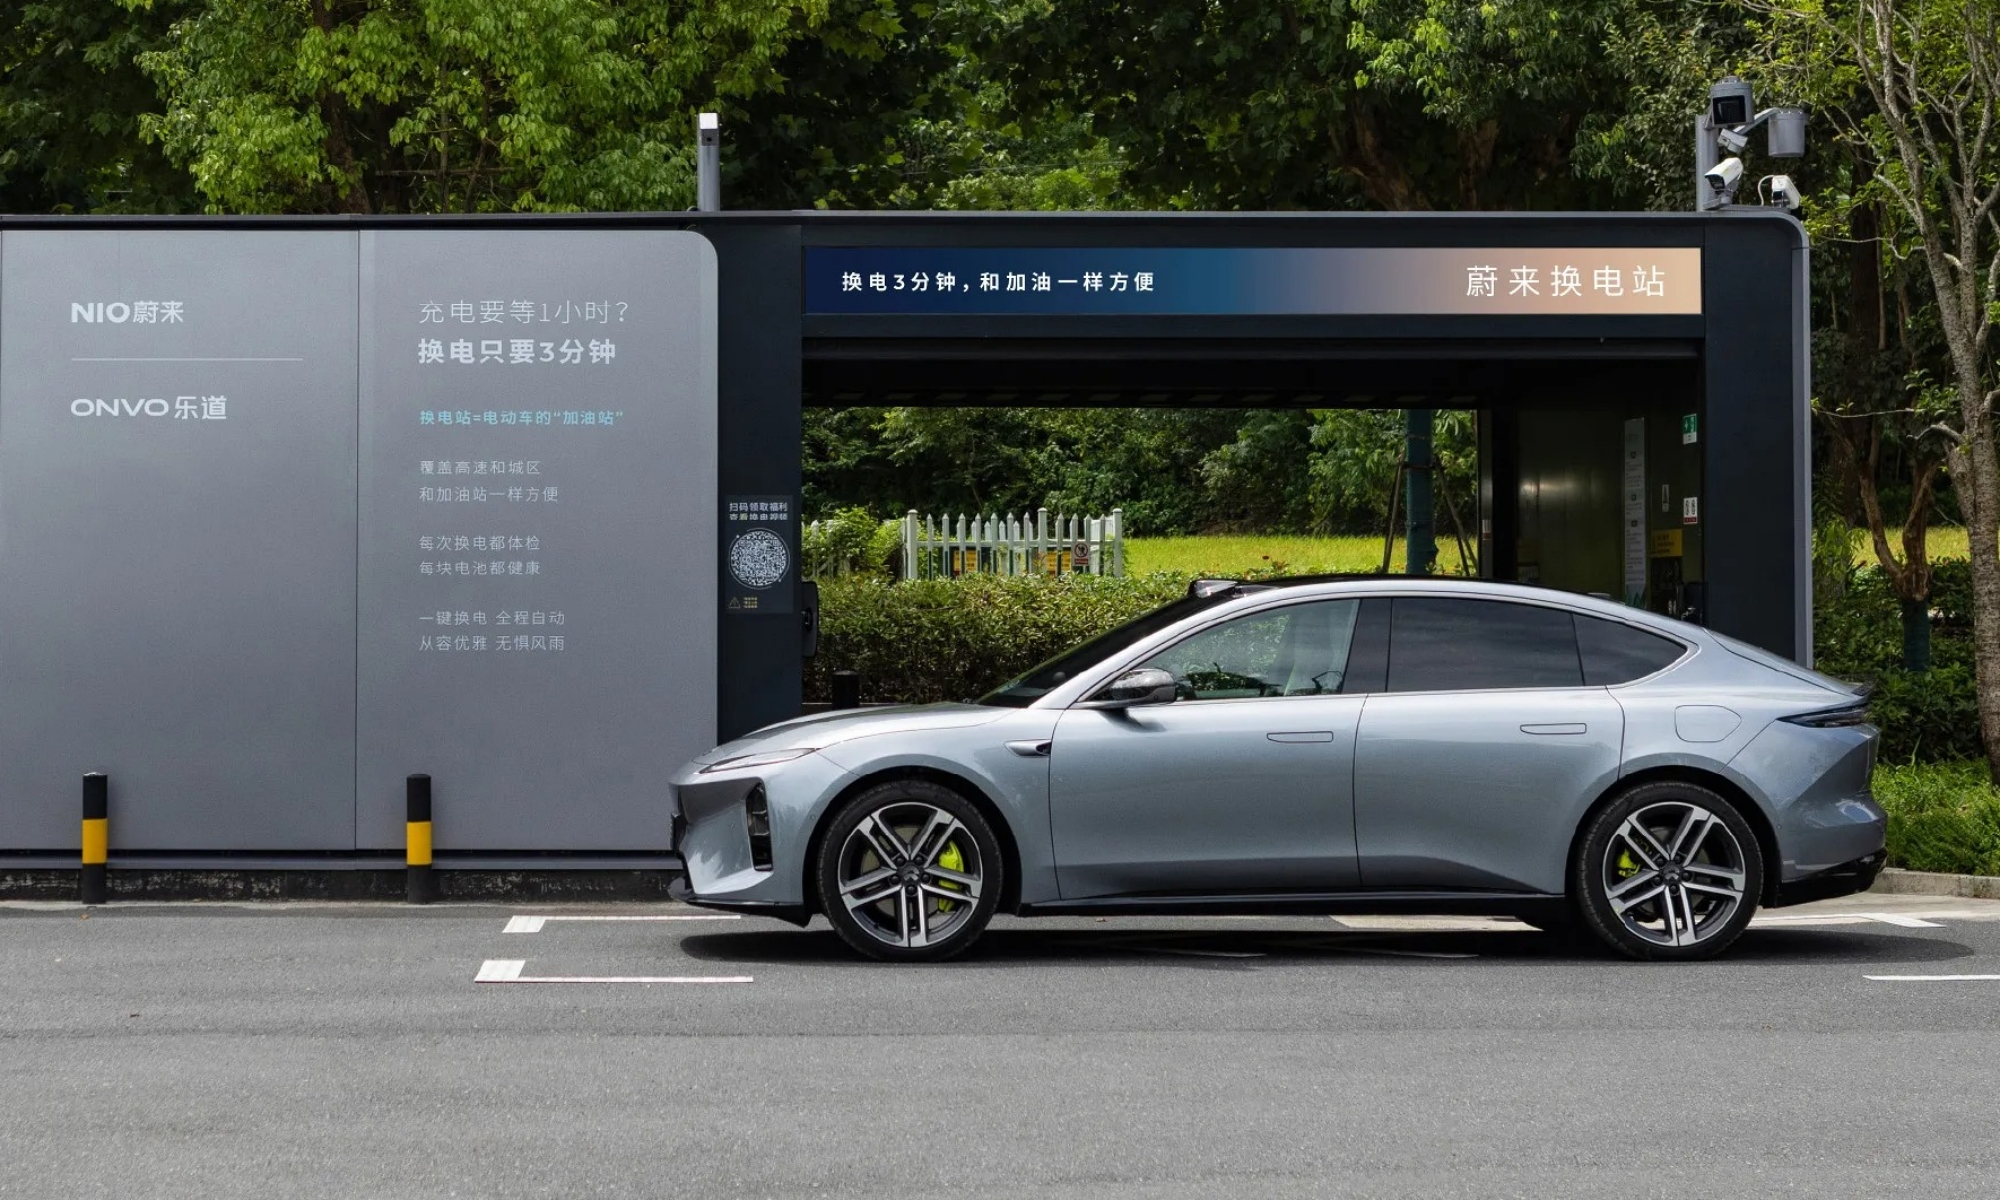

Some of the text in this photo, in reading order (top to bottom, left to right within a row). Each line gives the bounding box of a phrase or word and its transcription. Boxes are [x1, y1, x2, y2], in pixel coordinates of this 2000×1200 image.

[842, 271, 1154, 292] 换电3分钟，和加油一样方便
[1466, 264, 1665, 297] 蔚来换电站
[418, 299, 629, 324] 充电要等1小时？
[418, 338, 616, 365] 换电只要3分钟
[419, 460, 541, 475] 覆盖高速和城区
[419, 486, 558, 503] 和加油站一样方便
[419, 535, 540, 551] 每次换电都体检
[419, 561, 541, 576] 每块电池都健康
[419, 610, 565, 626] 一键换电 全程自动
[419, 635, 565, 651] 从容优雅 无惧风雨
